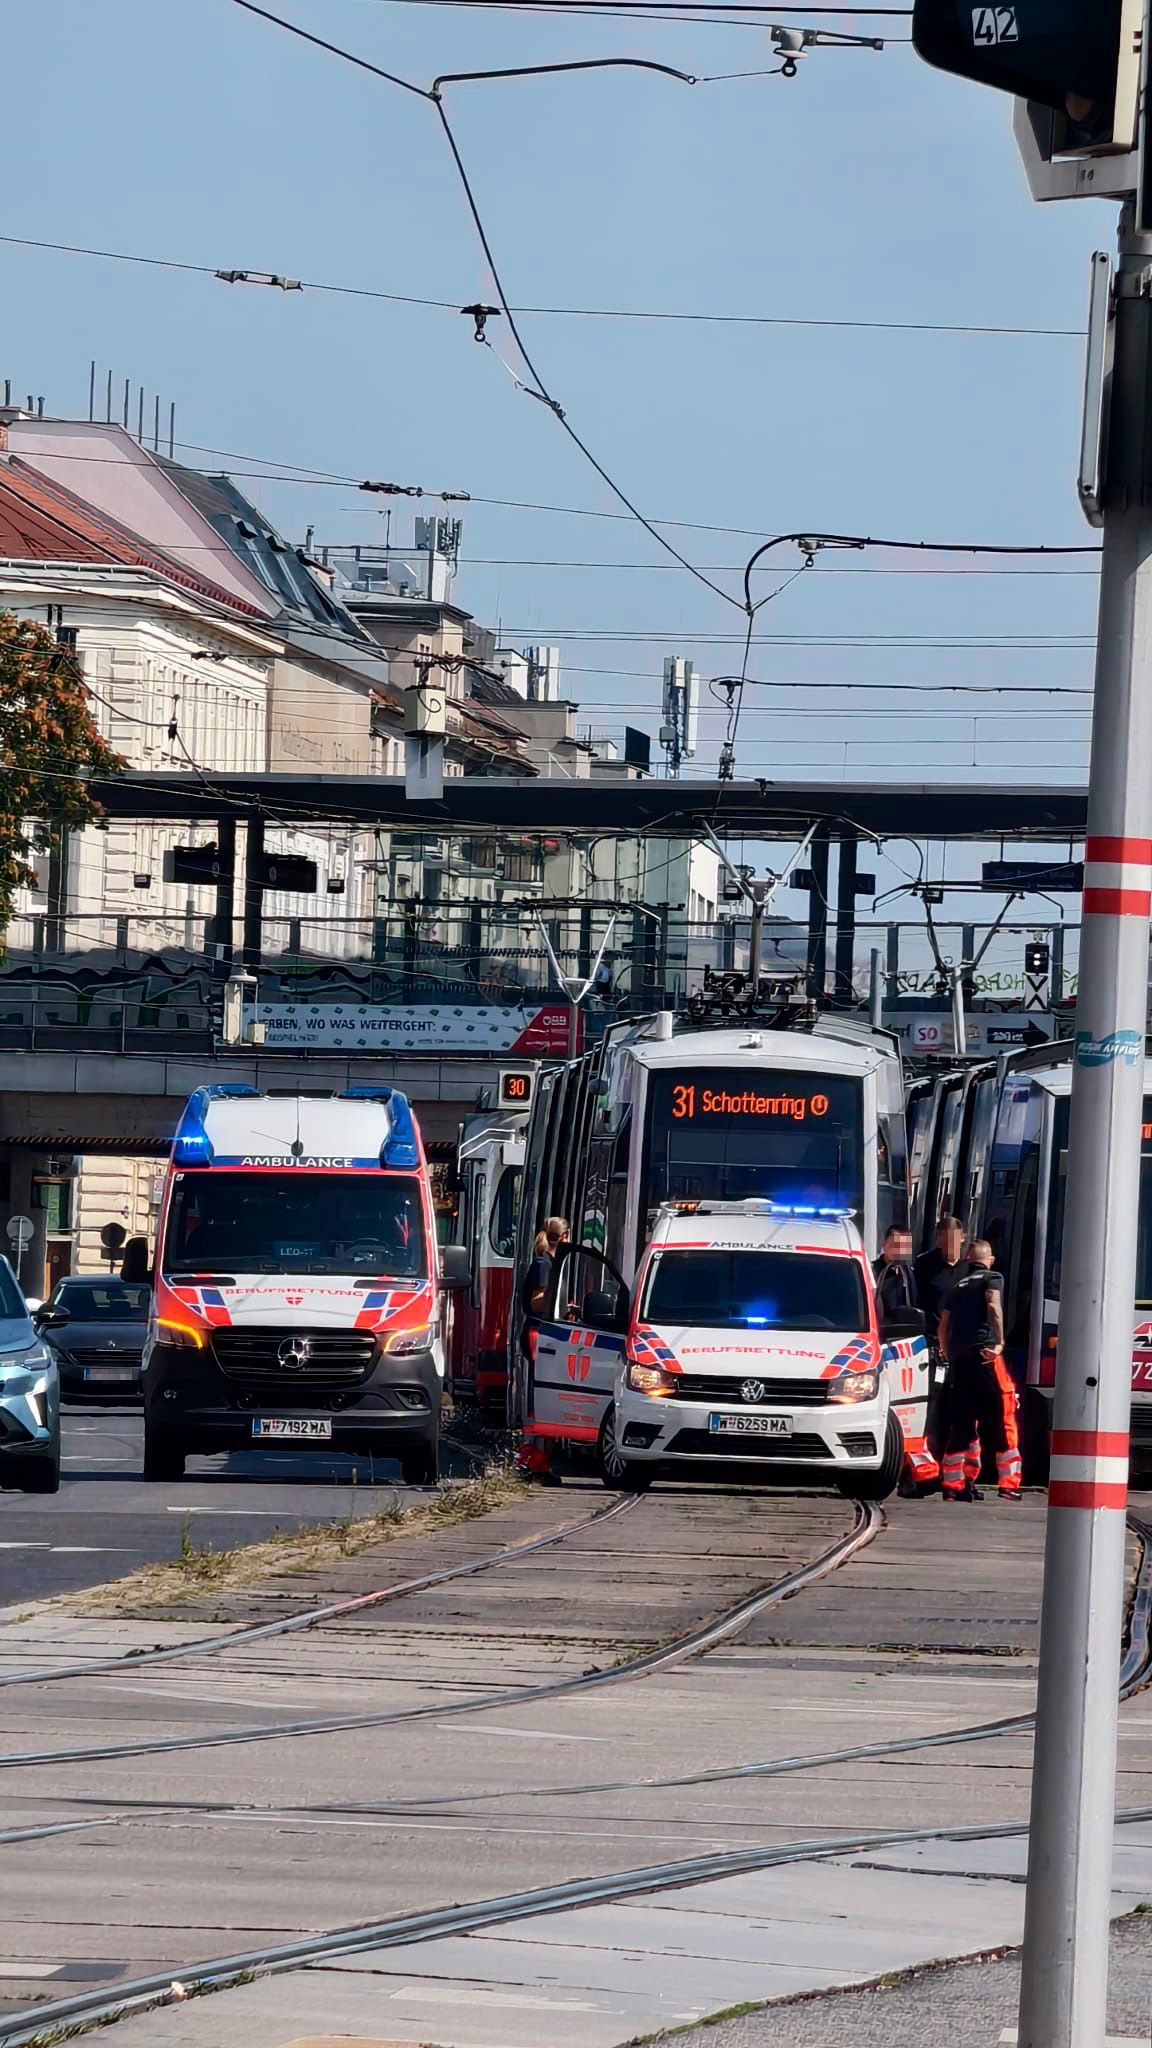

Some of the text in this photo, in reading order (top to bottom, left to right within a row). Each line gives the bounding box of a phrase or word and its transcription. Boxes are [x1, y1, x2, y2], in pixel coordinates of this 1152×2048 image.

[975, 7, 1018, 44] 42
[306, 1018, 326, 1030] WO
[330, 1018, 356, 1030] WAS
[360, 1019, 436, 1032] WEITERGEHT:
[509, 1078, 525, 1096] 30
[672, 1086, 694, 1118] 31
[702, 1090, 805, 1120] Schottenring
[240, 1156, 353, 1168] AMBULANCE
[710, 1241, 793, 1250] AMBULANCE
[225, 1287, 364, 1297] BERUFSRETTUNG
[681, 1346, 826, 1359] BERUFSRETTUNG
